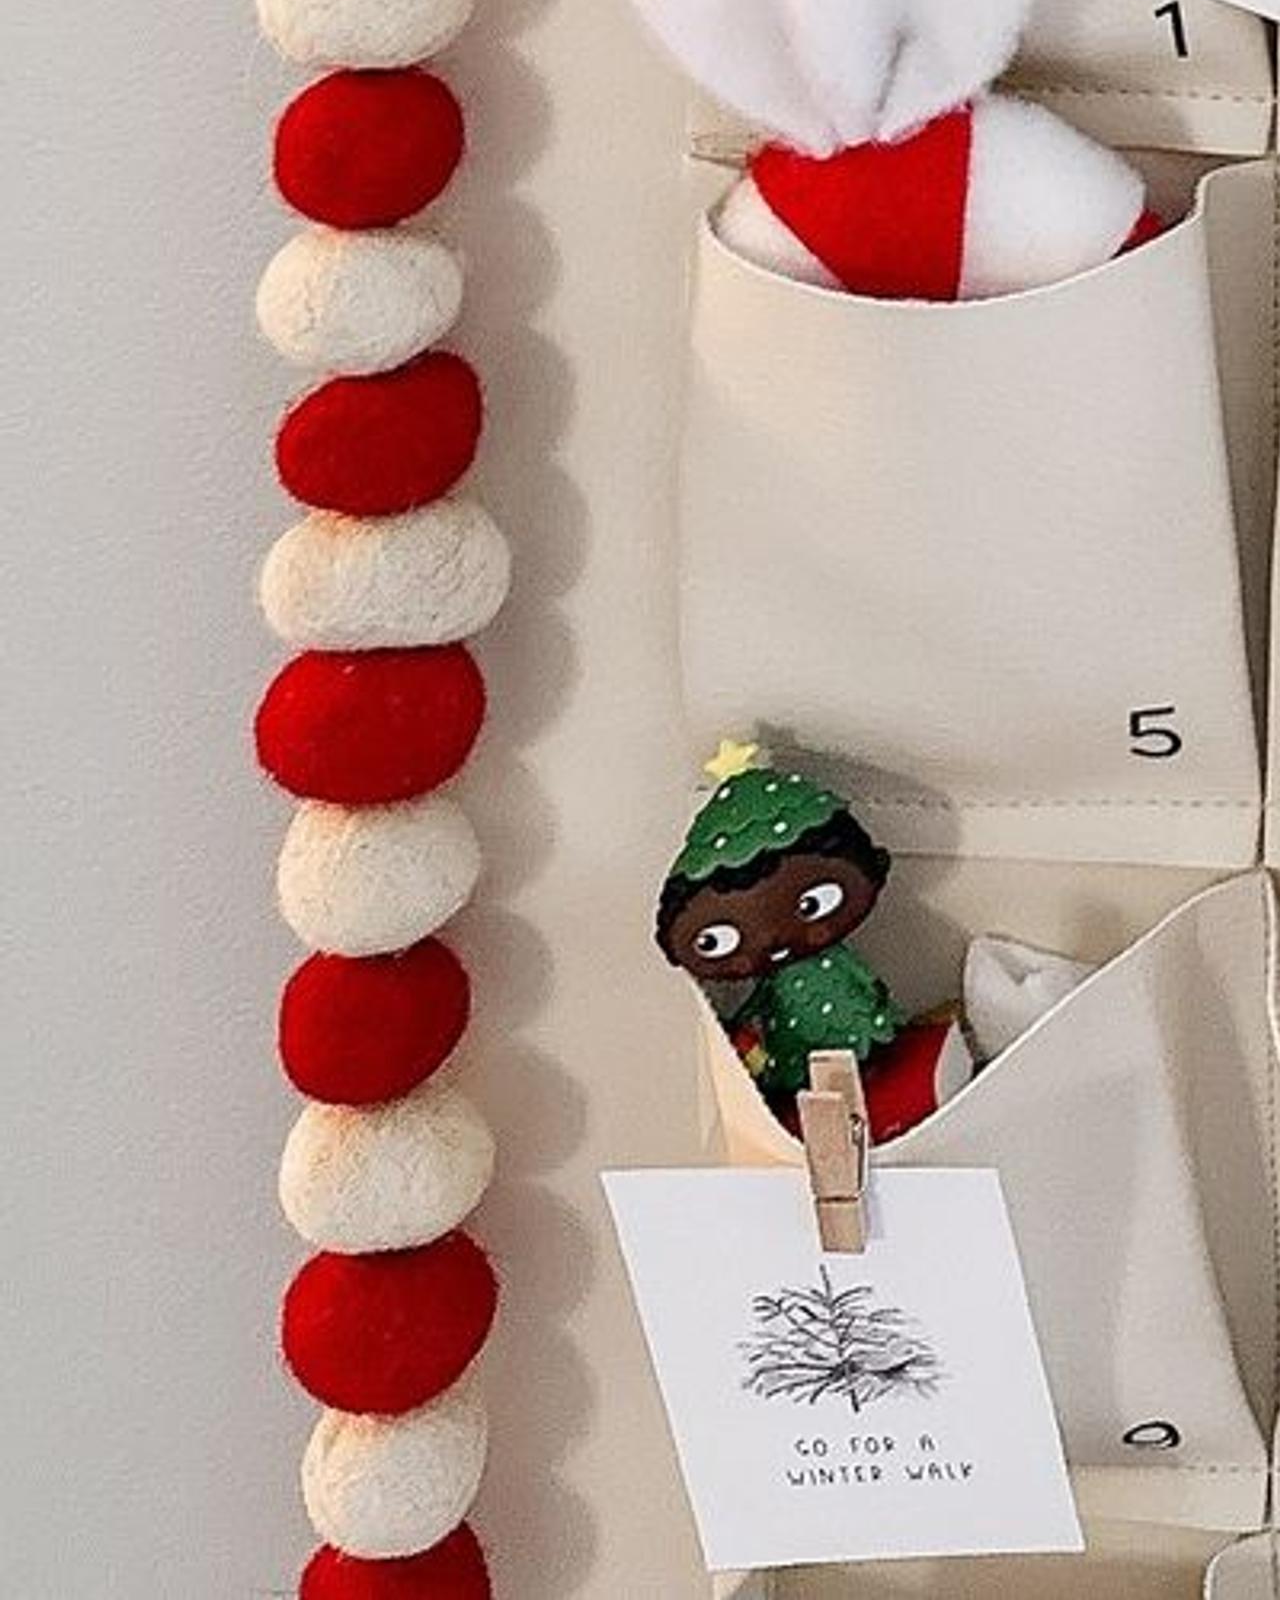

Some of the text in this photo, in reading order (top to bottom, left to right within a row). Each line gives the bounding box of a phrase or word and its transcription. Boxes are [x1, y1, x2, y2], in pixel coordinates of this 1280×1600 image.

[1154, 0, 1189, 59] 1
[1129, 706, 1183, 759] 5
[795, 1433, 935, 1456] GO FOR A
[787, 1462, 972, 1486] WINTER WALK
